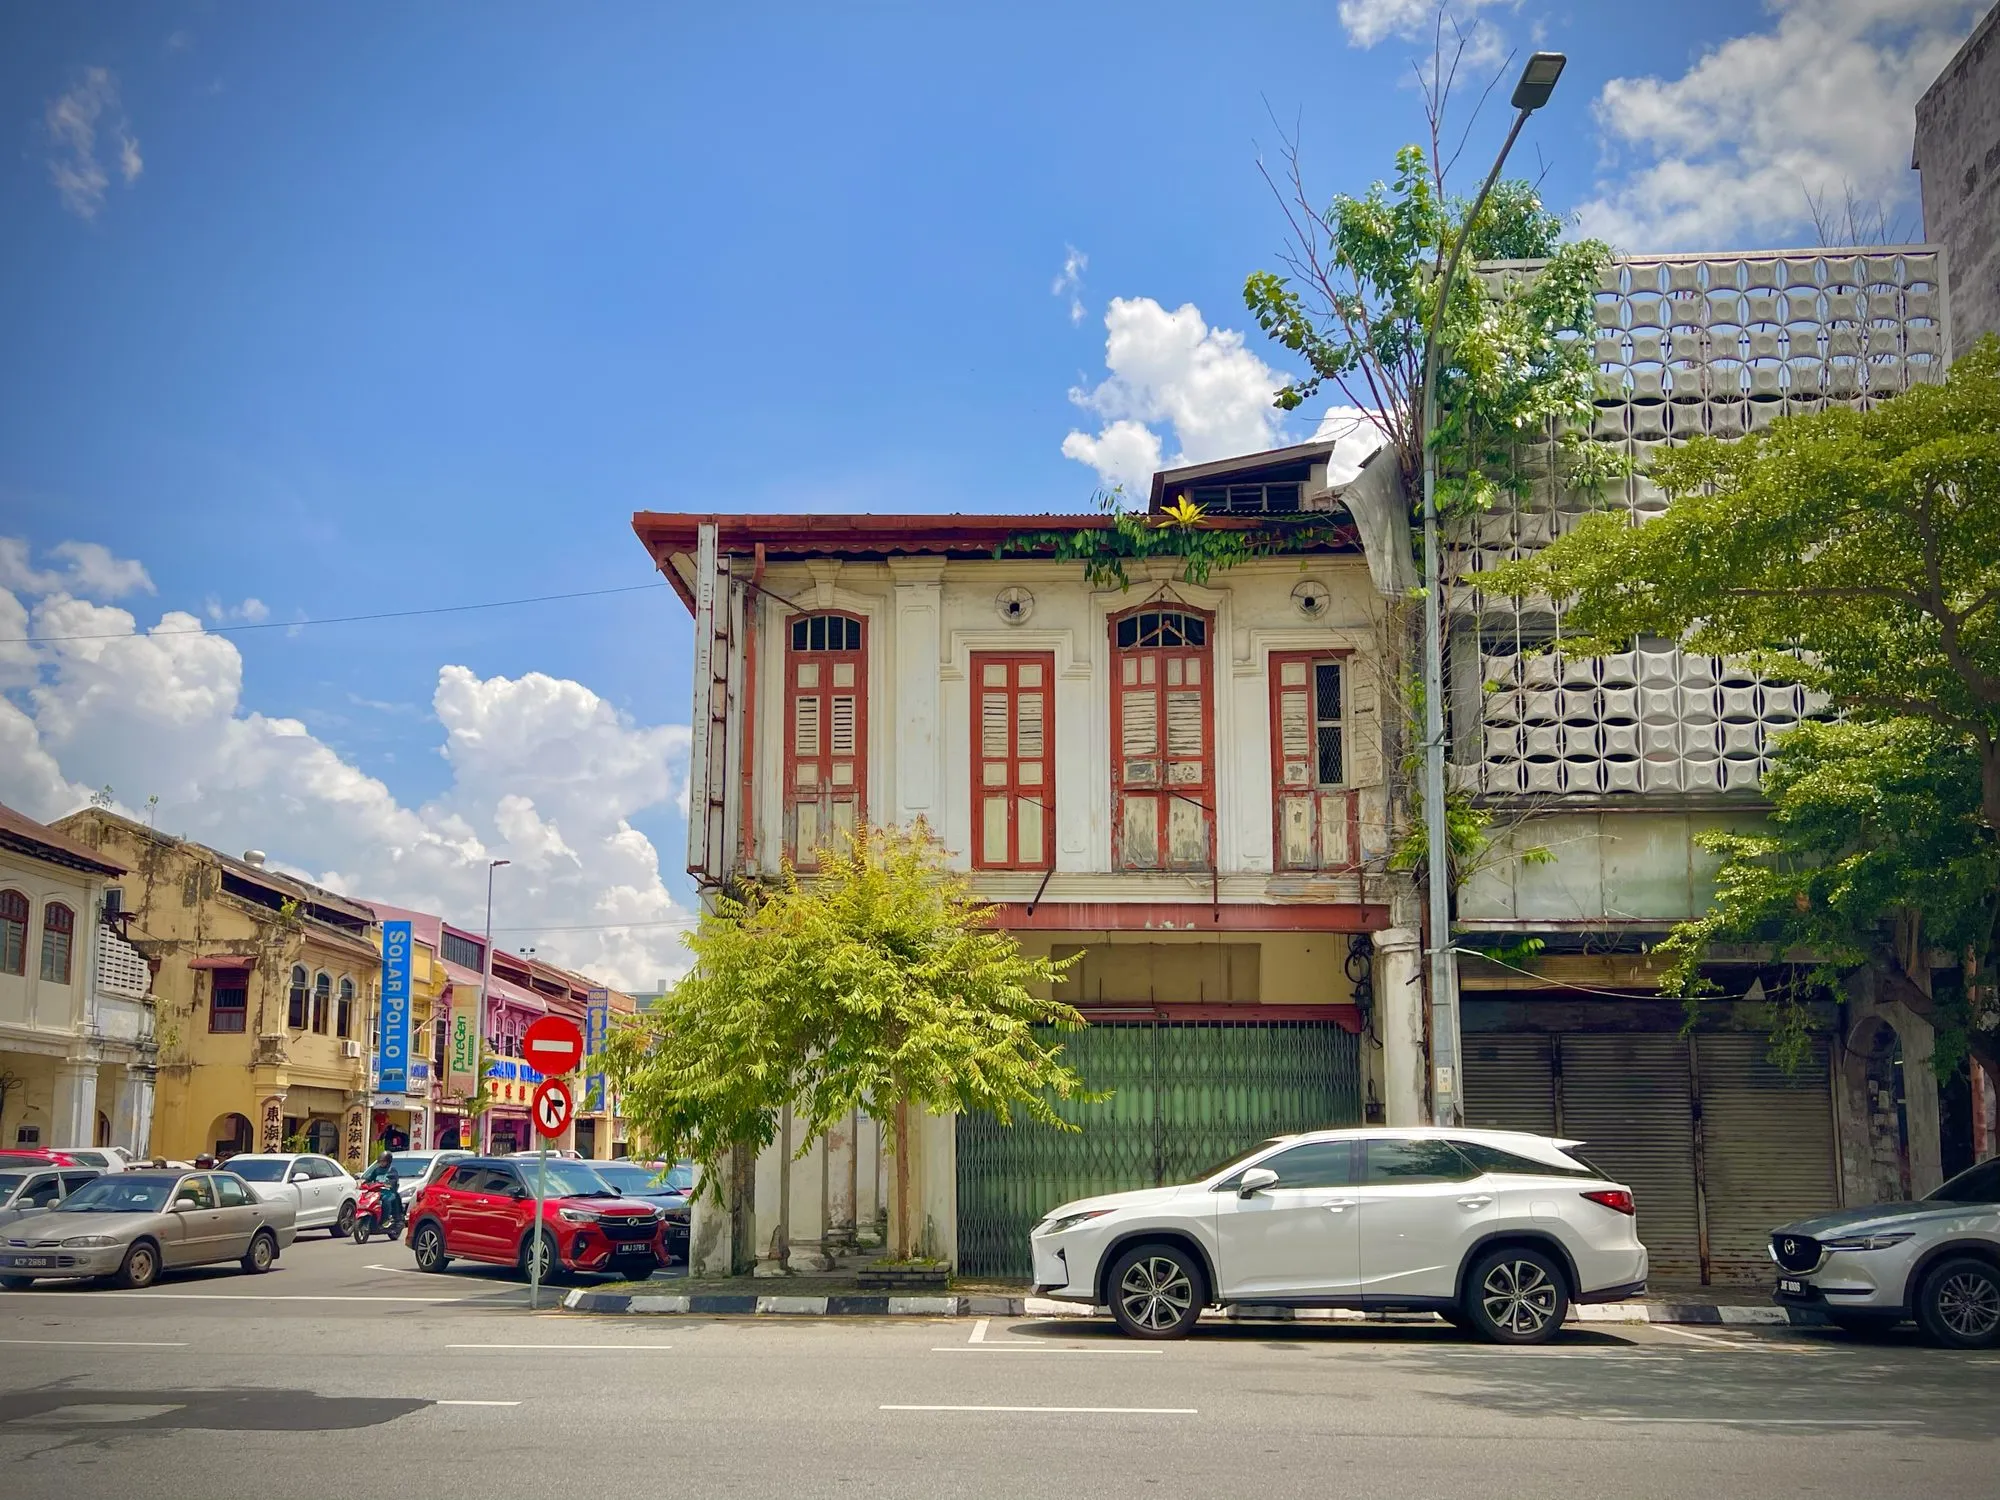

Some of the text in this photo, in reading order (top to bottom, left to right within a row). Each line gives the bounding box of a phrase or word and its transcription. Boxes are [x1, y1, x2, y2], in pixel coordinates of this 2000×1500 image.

[385, 930, 407, 1059] SOLAR POLLO
[453, 1015, 470, 1073] PureGen
